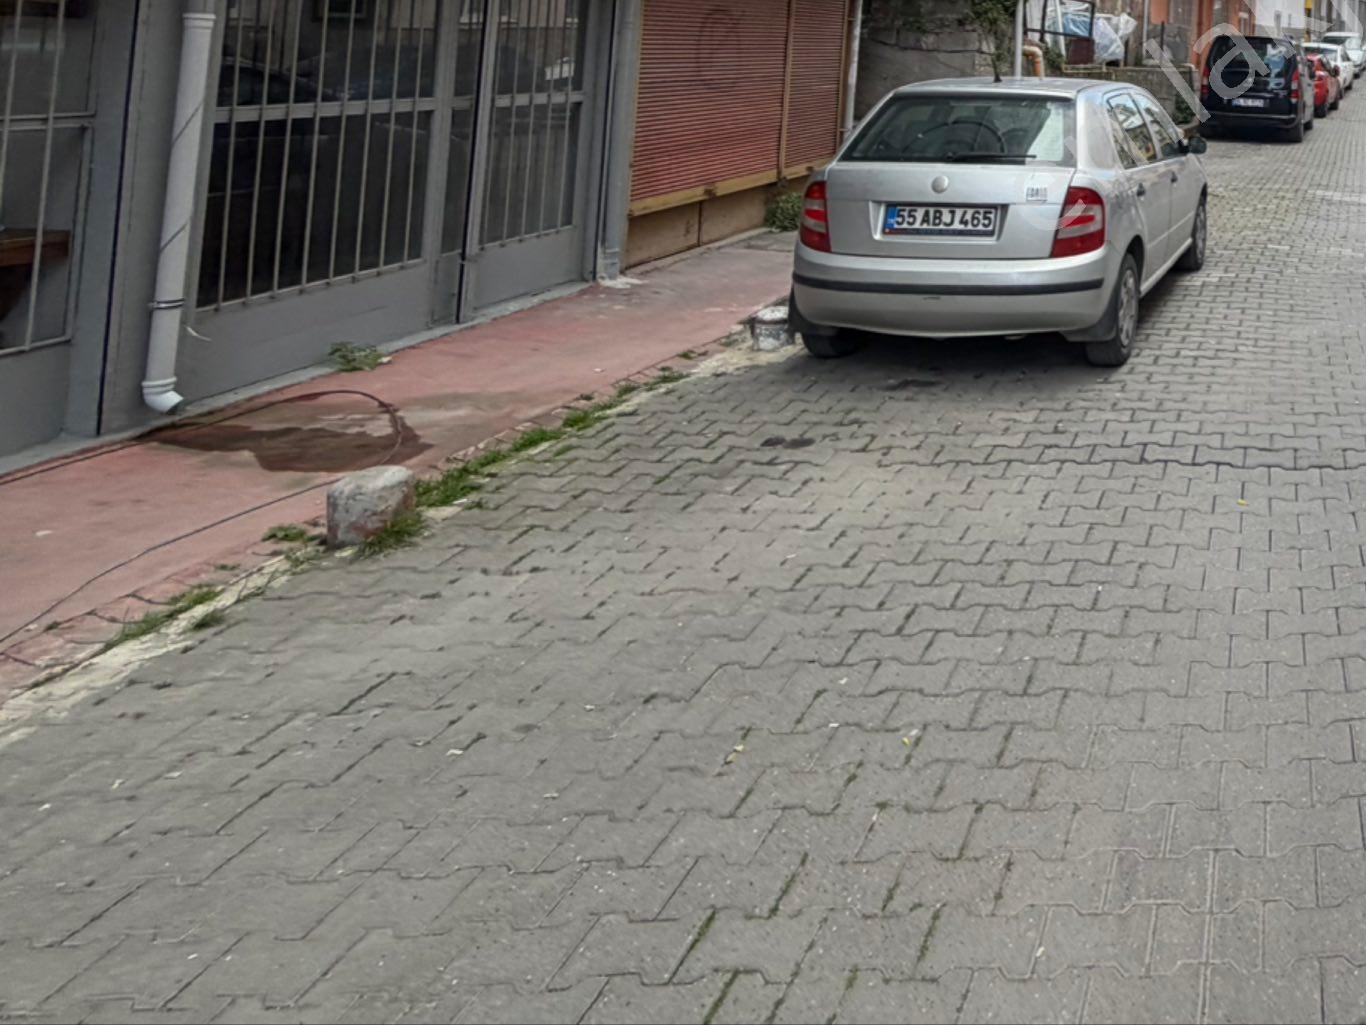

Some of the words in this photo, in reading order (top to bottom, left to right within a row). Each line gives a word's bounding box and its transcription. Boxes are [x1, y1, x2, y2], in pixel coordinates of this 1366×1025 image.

[896, 208, 917, 226] 55
[920, 209, 956, 227] ABJ
[959, 210, 993, 228] 465
